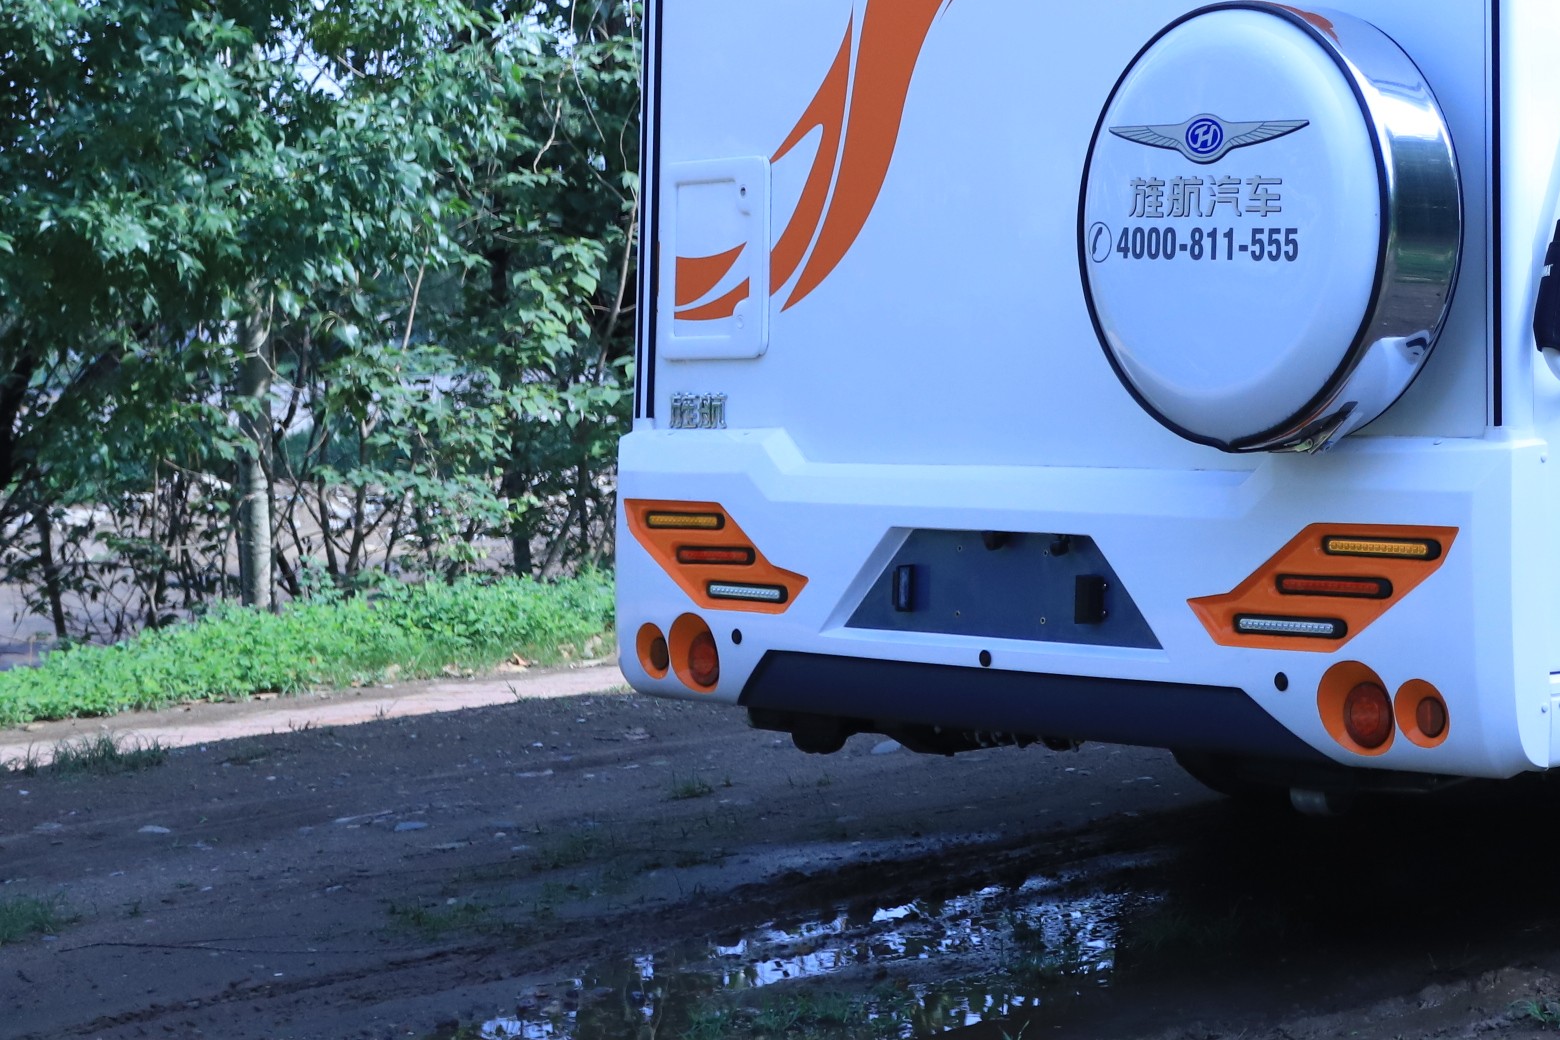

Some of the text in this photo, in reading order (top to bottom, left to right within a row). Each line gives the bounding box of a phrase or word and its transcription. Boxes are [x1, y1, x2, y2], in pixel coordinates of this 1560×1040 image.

[1128, 175, 1283, 218] 旌航汽车
[1116, 226, 1299, 262] 4000-811-555
